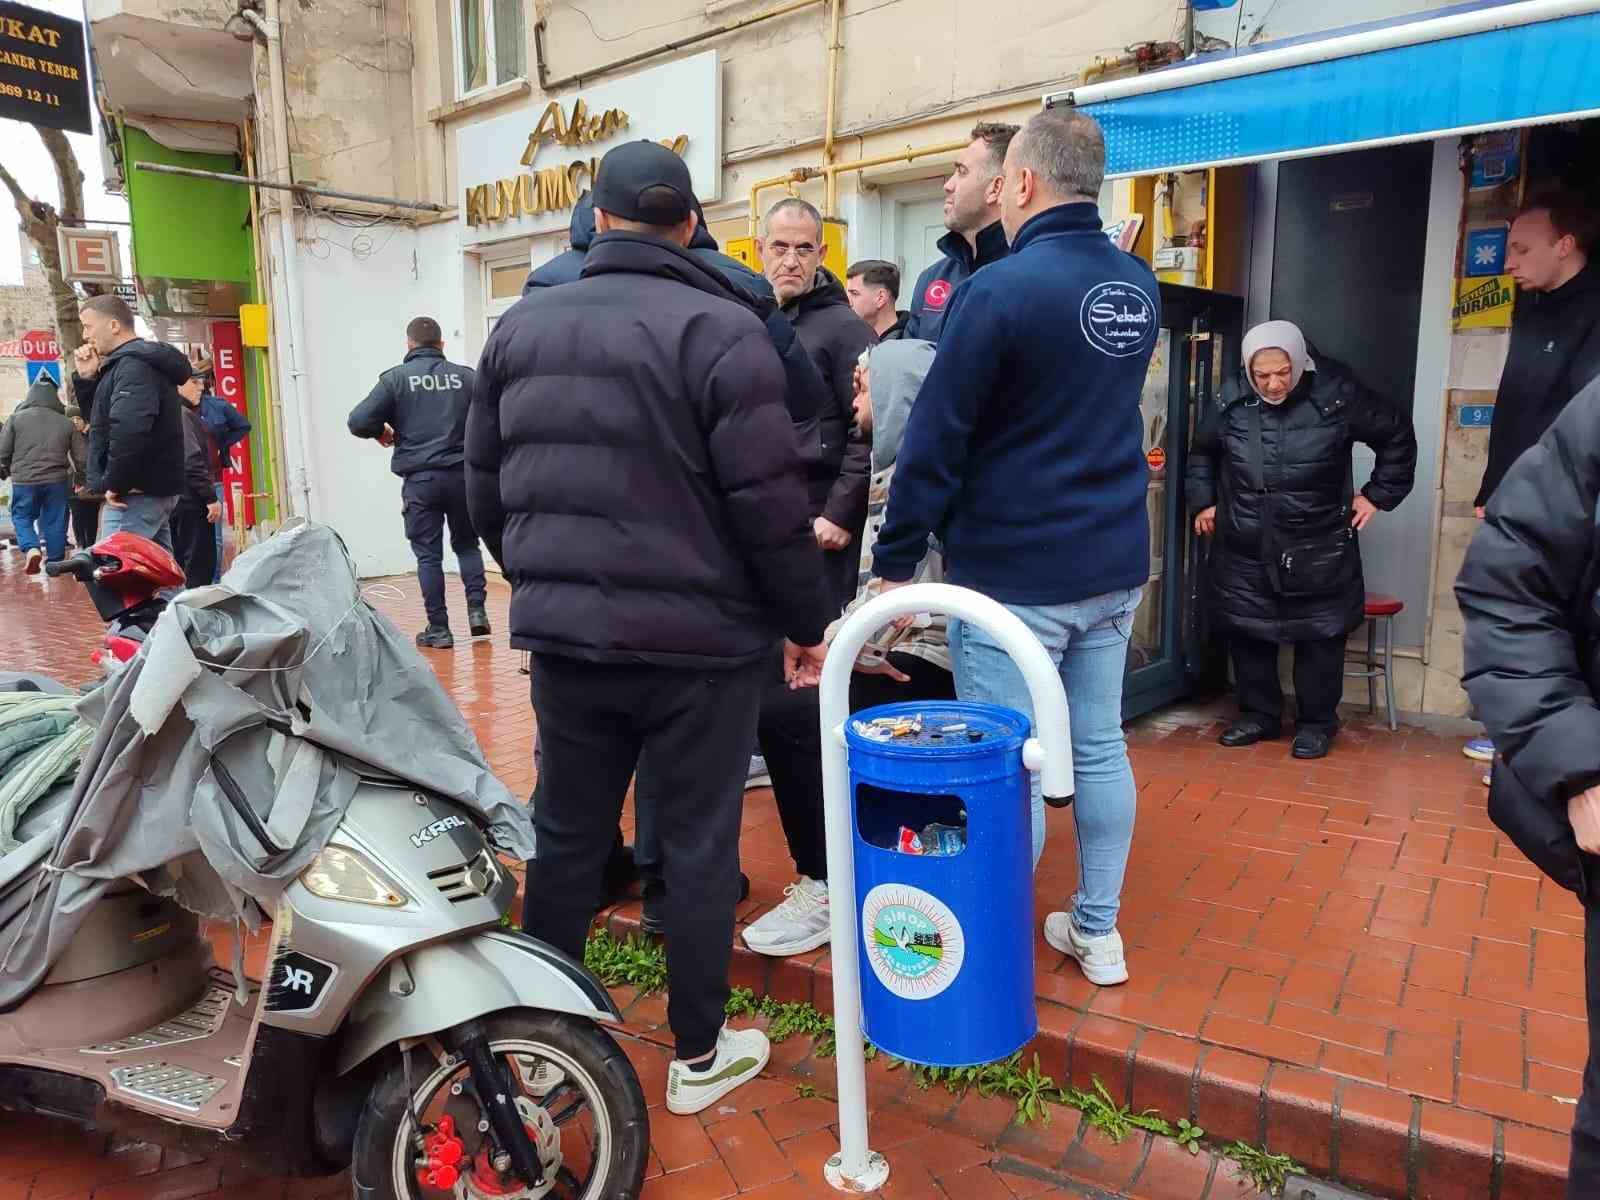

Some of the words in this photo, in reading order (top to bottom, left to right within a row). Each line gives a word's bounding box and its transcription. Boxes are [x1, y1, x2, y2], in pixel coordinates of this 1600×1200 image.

[0, 16, 61, 48] KAT
[39, 59, 79, 80] YENER
[26, 88, 42, 102] 12
[46, 93, 60, 106] 11
[76, 241, 106, 272] E
[1092, 304, 1148, 323] Sebat
[22, 340, 60, 356] DUR
[409, 815, 466, 848] KRAL
